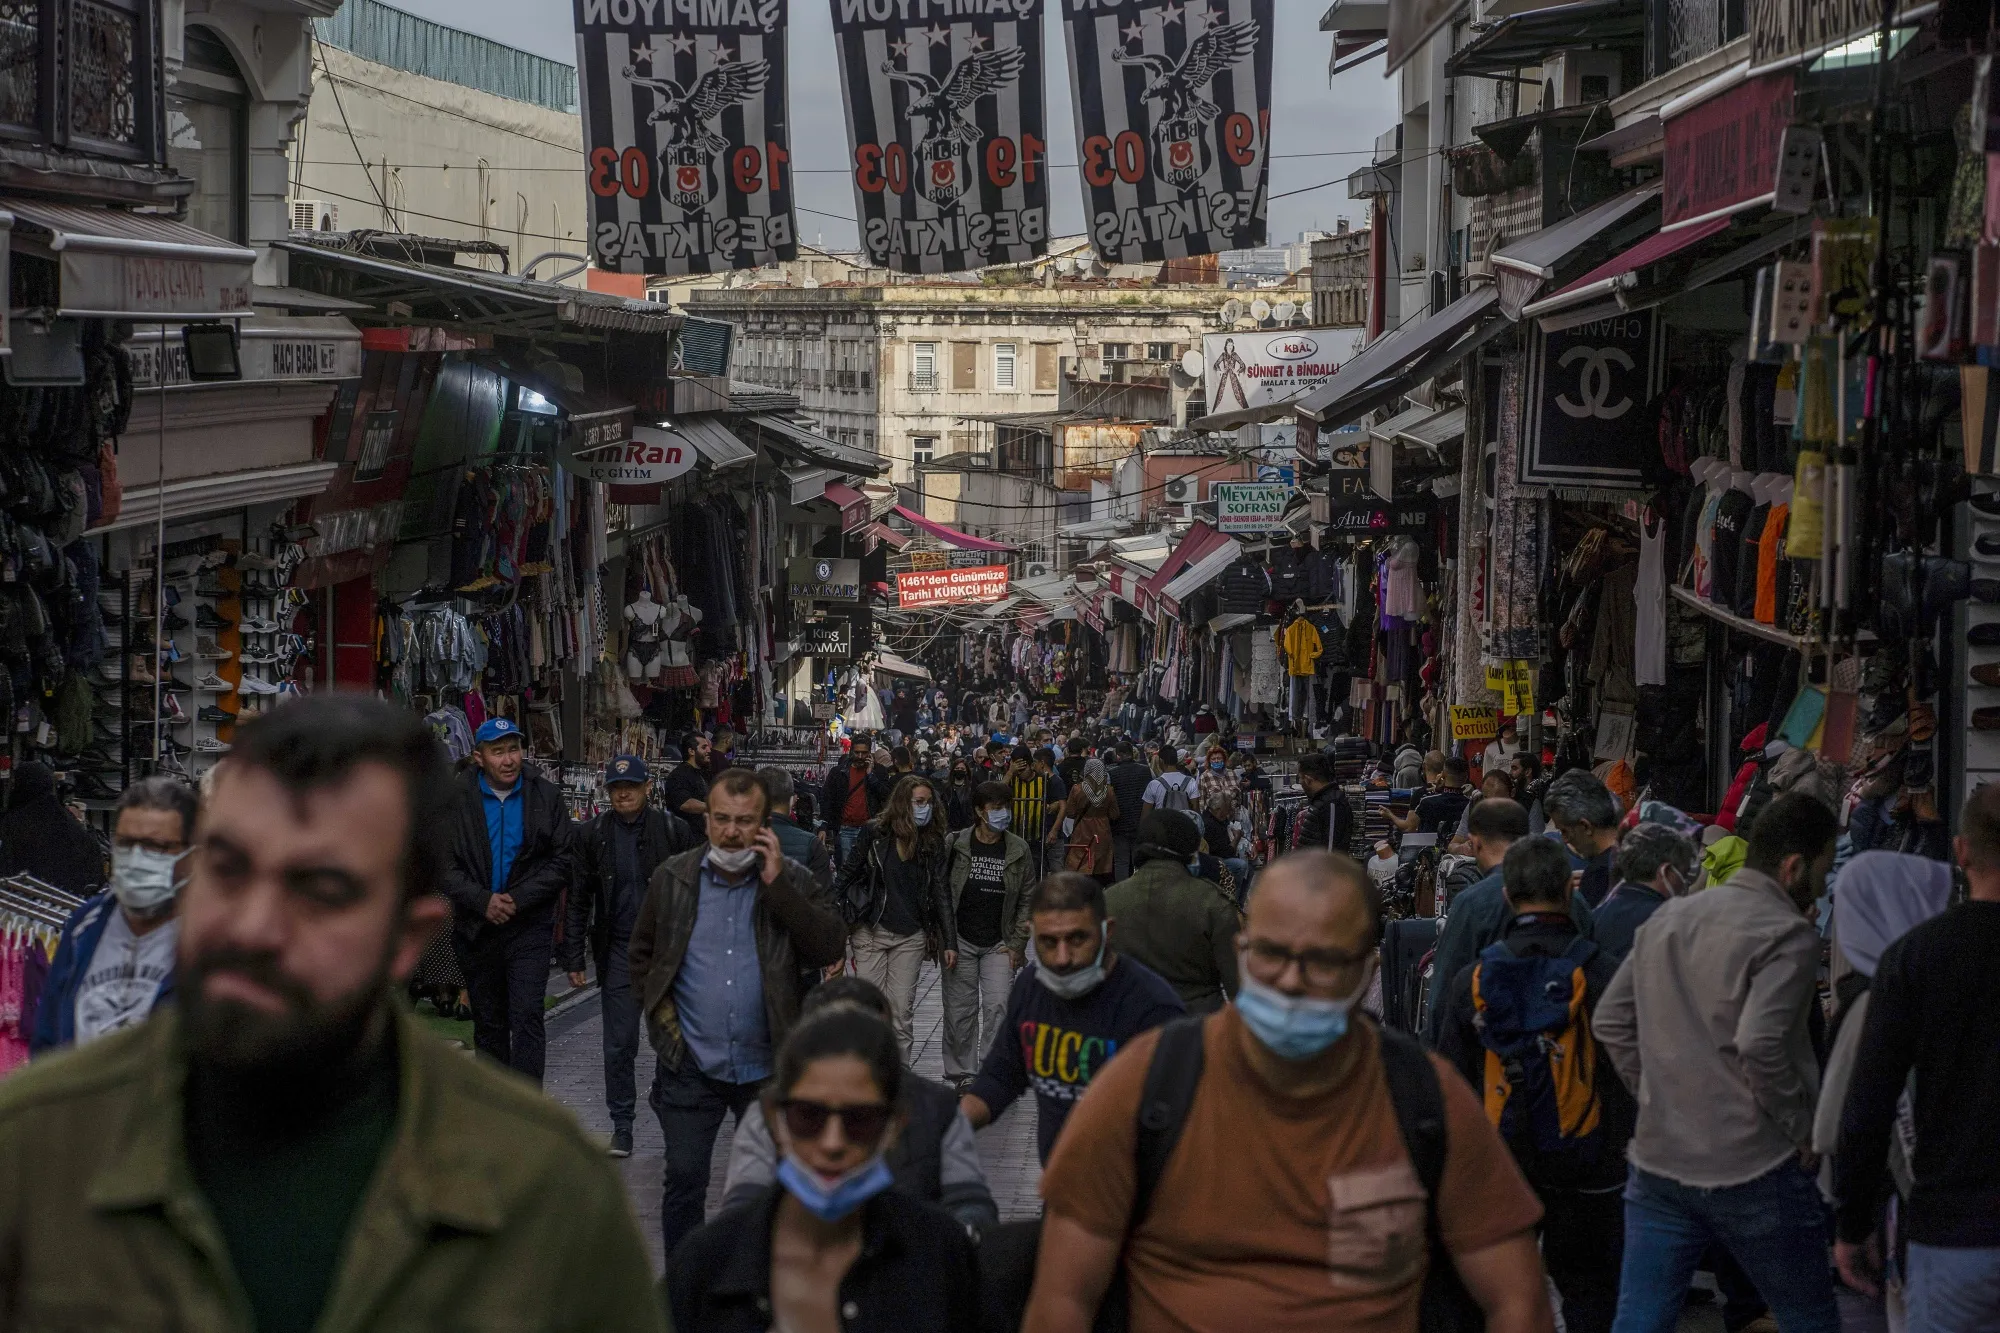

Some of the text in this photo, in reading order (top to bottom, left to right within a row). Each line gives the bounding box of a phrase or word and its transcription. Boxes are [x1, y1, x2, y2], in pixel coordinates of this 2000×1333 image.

[272, 343, 294, 375] HACI
[296, 344, 318, 374] BABA
[1247, 363, 1285, 378] SÜNNET
[1287, 366, 1293, 377] &
[1261, 378, 1288, 387] İMALAT
[1298, 378, 1328, 386] TOPTAN
[590, 466, 652, 480] İÇ GİYİM
[1227, 502, 1281, 514] SOFRASI
[1400, 512, 1427, 526] NB
[901, 570, 1005, 588] 1461'den Günümüze
[902, 588, 931, 601] Tarihi
[812, 628, 840, 642] King
[1454, 707, 1494, 720] YATAK
[1455, 720, 1496, 736] ÖRTÜSÜ
